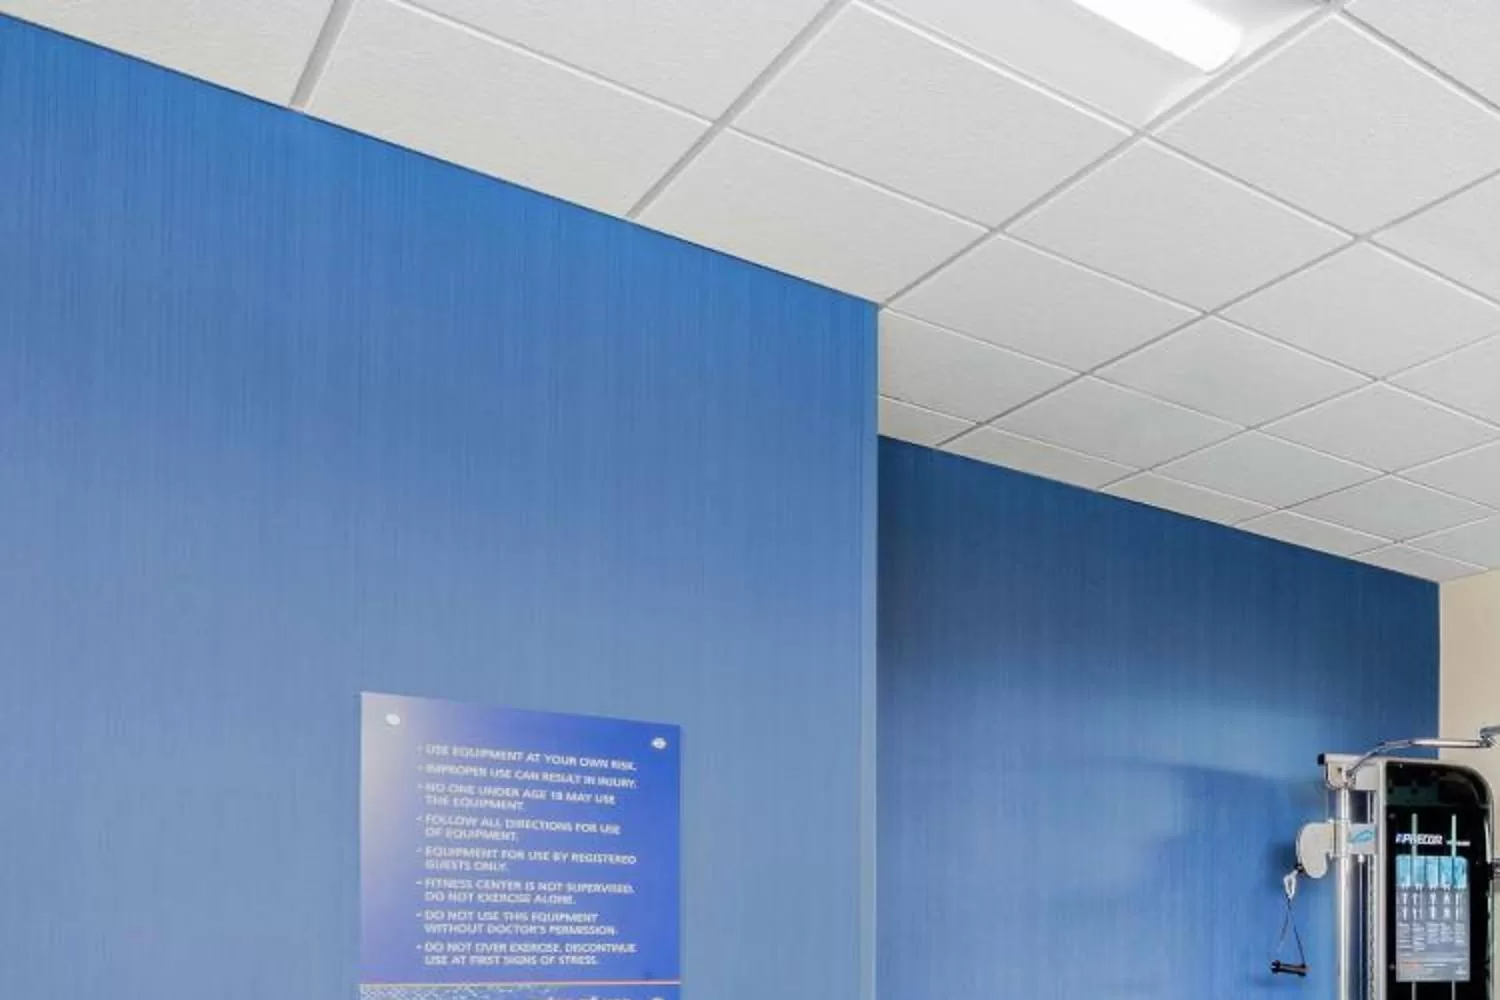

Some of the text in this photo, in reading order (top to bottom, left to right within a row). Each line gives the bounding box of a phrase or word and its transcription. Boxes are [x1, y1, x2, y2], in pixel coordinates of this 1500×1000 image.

[452, 747, 524, 761] EQUIPMENT
[526, 751, 541, 763] AT
[544, 754, 577, 766] YOUR
[580, 757, 609, 769] OWN
[426, 764, 486, 776] IMPROPER
[489, 767, 512, 778] USE
[514, 769, 540, 780] CAN
[542, 771, 581, 784] RESULT
[583, 775, 596, 785] IN
[426, 783, 445, 793] NO
[448, 784, 475, 795] ONE
[479, 786, 520, 797] UNDER
[522, 788, 548, 800] AGE
[566, 792, 592, 803] MAY
[595, 794, 616, 805] USE
[424, 795, 449, 806] THE
[425, 814, 621, 835] FOLLOW ALL DIRECTIONS FOR USE
[425, 827, 441, 838] OF
[425, 846, 637, 865] EQUIPMENT FOR USE BY REGISTERED
[425, 859, 472, 871] GUESTS
[425, 878, 473, 889] FITNESS
[475, 880, 522, 892] CENTER
[525, 881, 535, 891] IS
[538, 881, 562, 892] NOT
[425, 891, 445, 901] DO
[447, 892, 474, 903] NOT
[478, 892, 531, 903] EXERCISE
[425, 911, 600, 923] DO NOT USE THIS EQUIPMENT
[424, 923, 485, 934] WITHOUT
[425, 943, 445, 953] DO
[447, 943, 473, 953] NOT
[475, 943, 507, 953] OVER
[564, 943, 638, 953] DISCONTINUE
[425, 955, 448, 965] USE
[450, 955, 466, 965] AT
[469, 955, 503, 965] FIRST
[506, 955, 537, 965] SIGNS
[540, 956, 556, 965] OF
